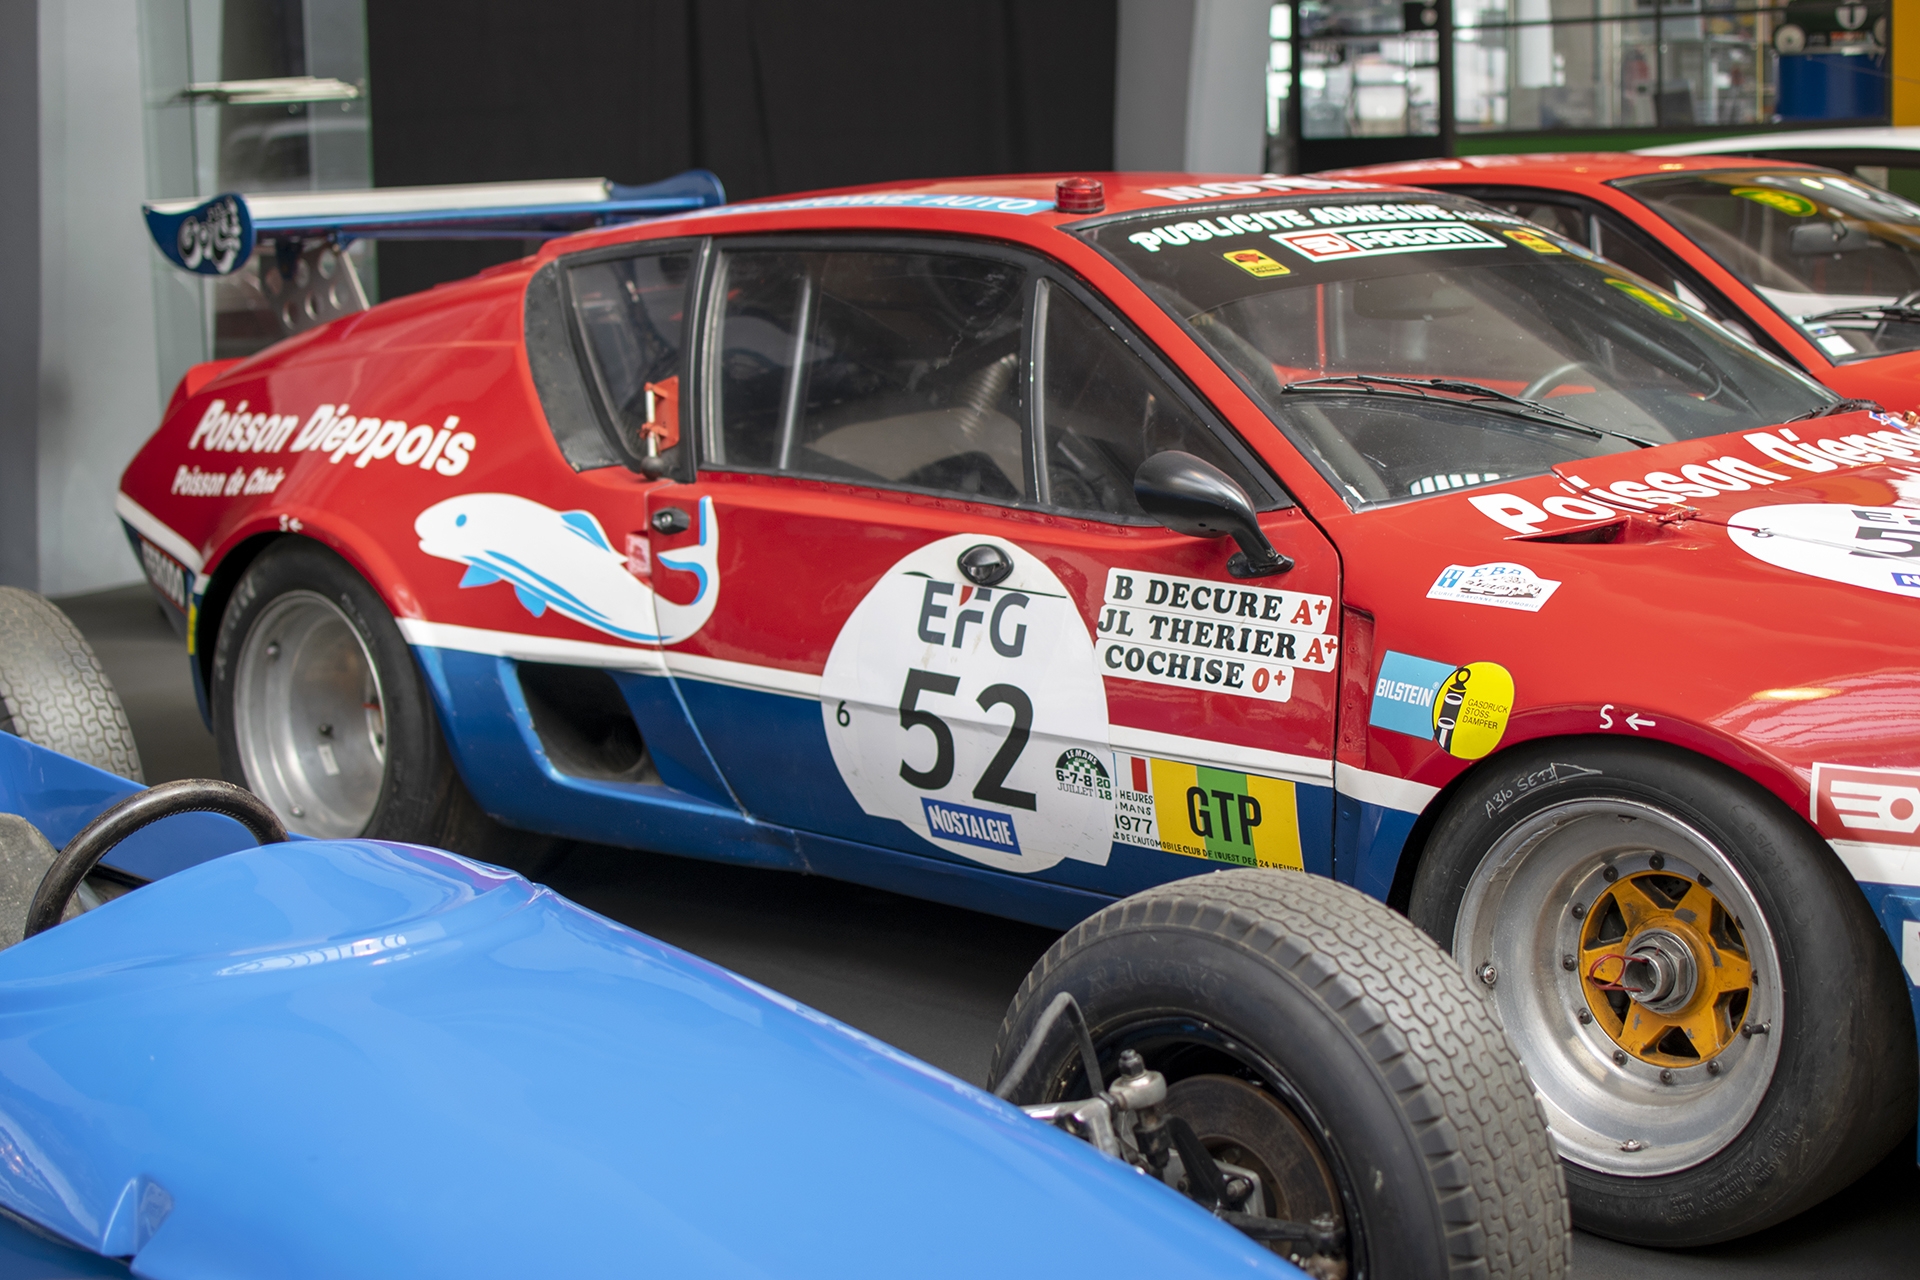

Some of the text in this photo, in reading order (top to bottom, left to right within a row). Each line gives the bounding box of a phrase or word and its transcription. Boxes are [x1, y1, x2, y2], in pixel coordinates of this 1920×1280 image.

[920, 194, 1038, 210] AUTO
[1128, 208, 1315, 252] PUBLICITE
[1309, 204, 1457, 226] ADHESIVE
[1346, 227, 1487, 250] FACOM
[188, 399, 476, 476] Poisson Dieppois
[171, 465, 227, 496] Poisson
[223, 466, 247, 497] de
[1468, 427, 1920, 535] Poisson Diepp
[1112, 575, 1328, 626] B DECURE A+
[1494, 599, 1539, 609] AUTOMOBILE
[917, 579, 1030, 658] EFG
[1097, 608, 1338, 665] JL THERIER A+
[1104, 644, 1245, 689] COCHISE
[1375, 678, 1434, 708] BILSTEIN
[1467, 699, 1509, 715] GASDRUCK
[836, 700, 851, 728] 6
[899, 667, 1038, 813] 52
[1056, 769, 1093, 788] 6-7-8
[1057, 782, 1094, 798] JUILLET
[1096, 777, 1111, 790] 20
[1098, 789, 1112, 801] 18
[1119, 790, 1154, 805] HEURES
[1119, 802, 1152, 816] MANS
[926, 804, 1015, 847] NOSTALGIE
[1115, 814, 1153, 835] 1977
[1186, 786, 1262, 846] GTP
[1182, 845, 1202, 857] CLUB
[1202, 848, 1213, 859] DE
